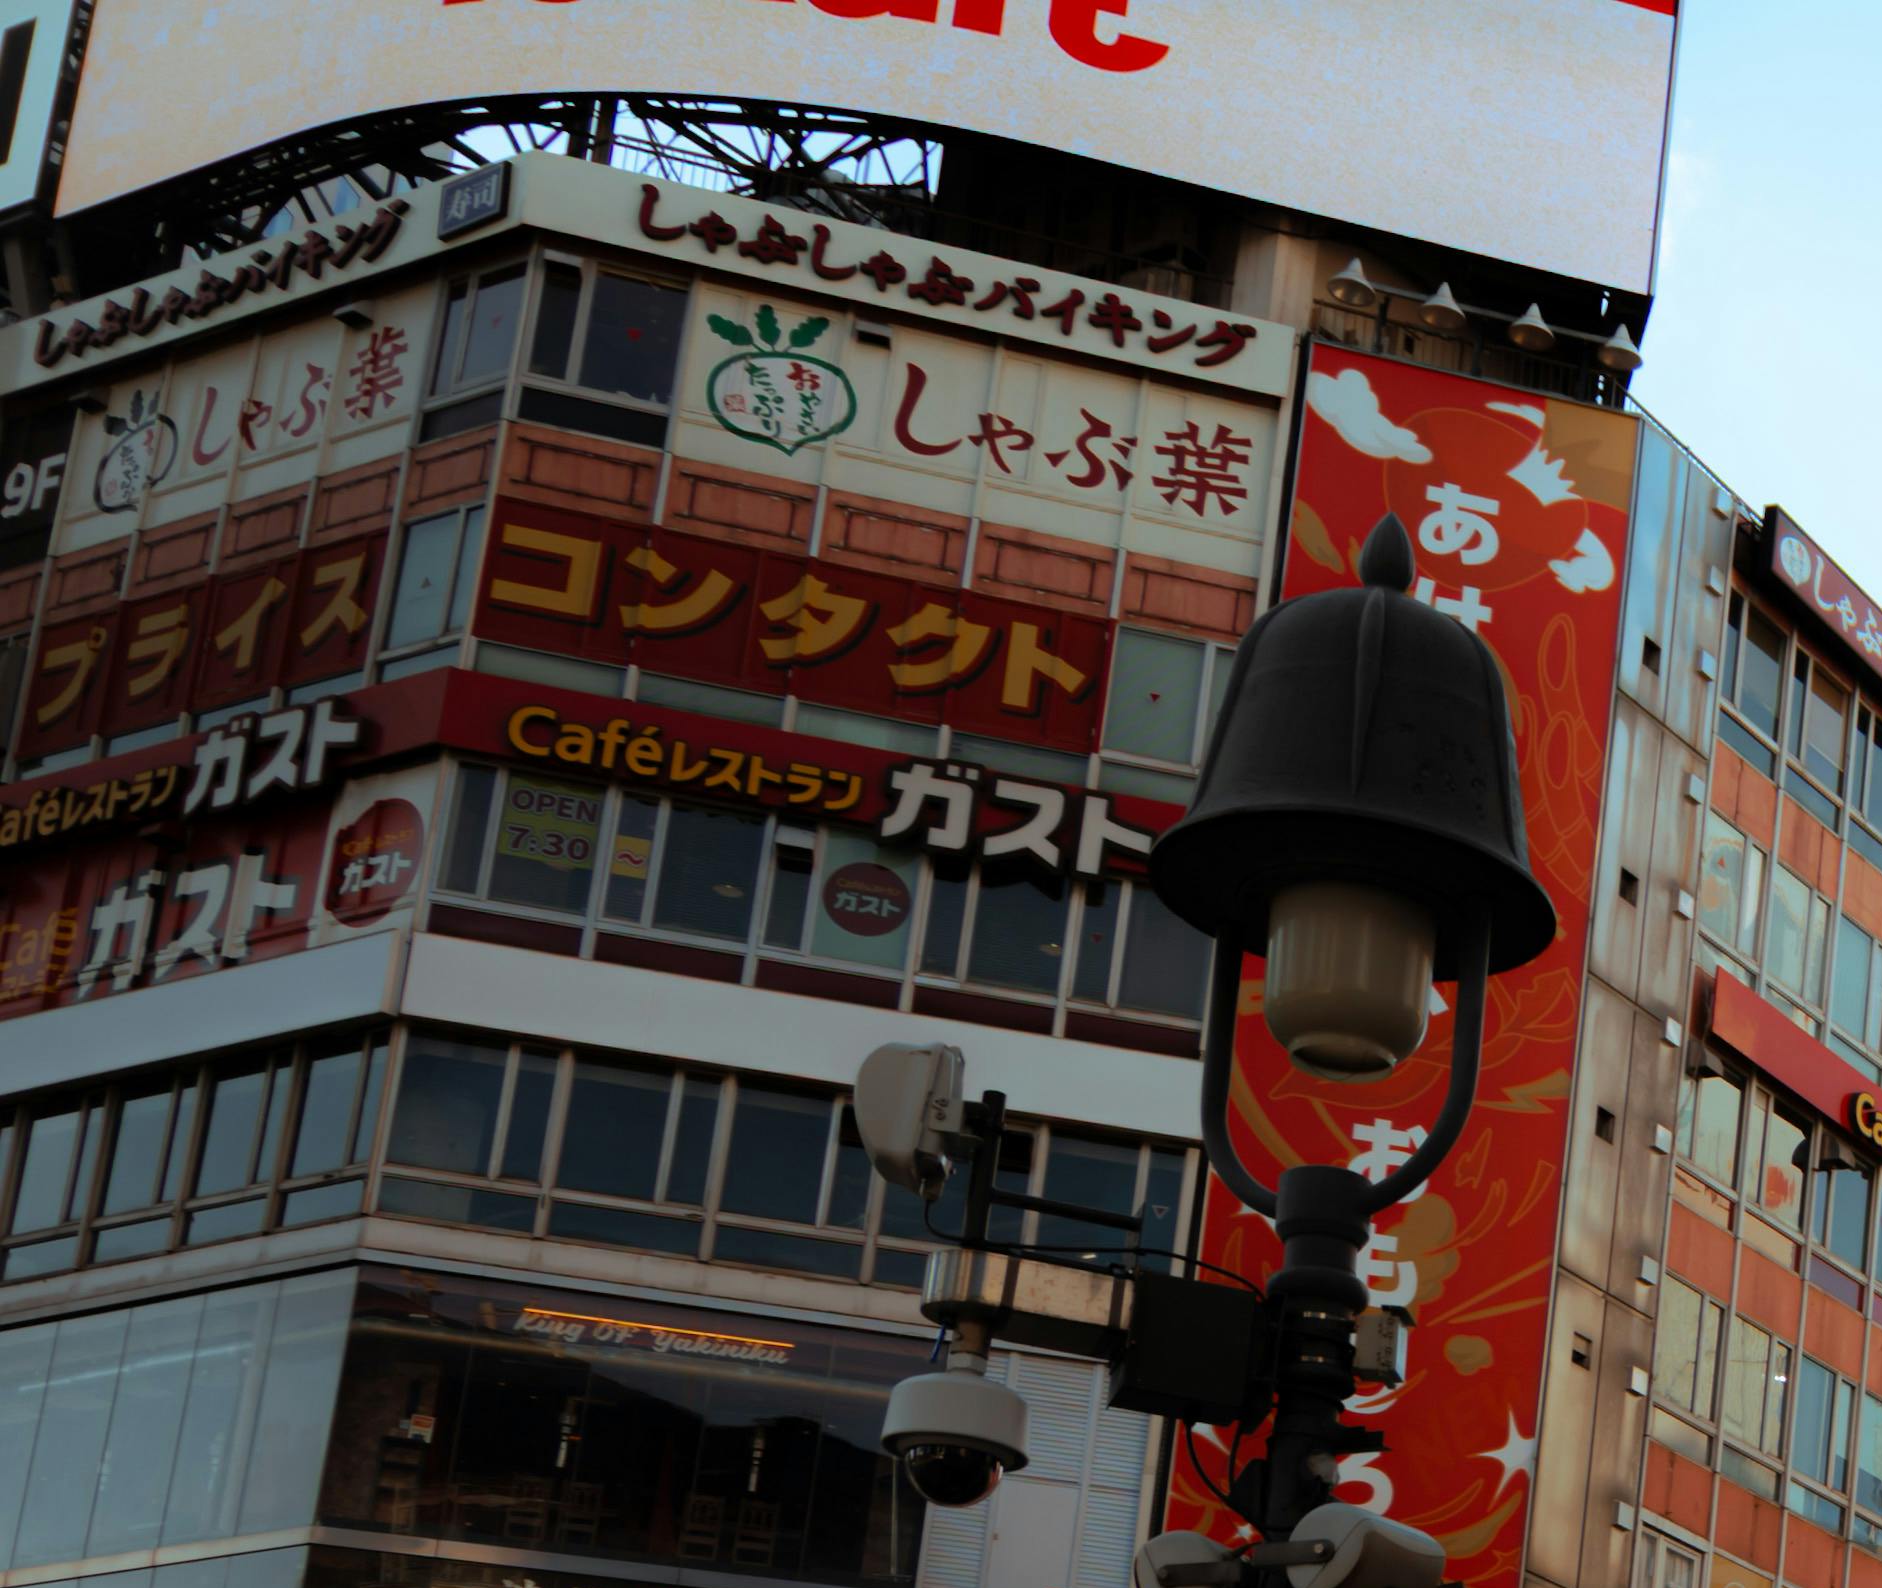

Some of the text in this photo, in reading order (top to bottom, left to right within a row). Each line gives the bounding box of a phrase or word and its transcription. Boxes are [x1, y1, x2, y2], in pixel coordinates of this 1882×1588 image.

[445, 180, 498, 223] 寿司
[640, 184, 1257, 367] しゃぶしゃぶバイキング
[192, 326, 409, 467] しゃぶ葉
[893, 362, 1254, 517] しゃぶ葉
[3, 453, 65, 519] 9F
[36, 552, 368, 726] プライス
[489, 523, 1088, 710] コンタクト
[185, 699, 360, 815] ガスト
[512, 788, 598, 825] OPEN
[881, 762, 1153, 875] ガスト
